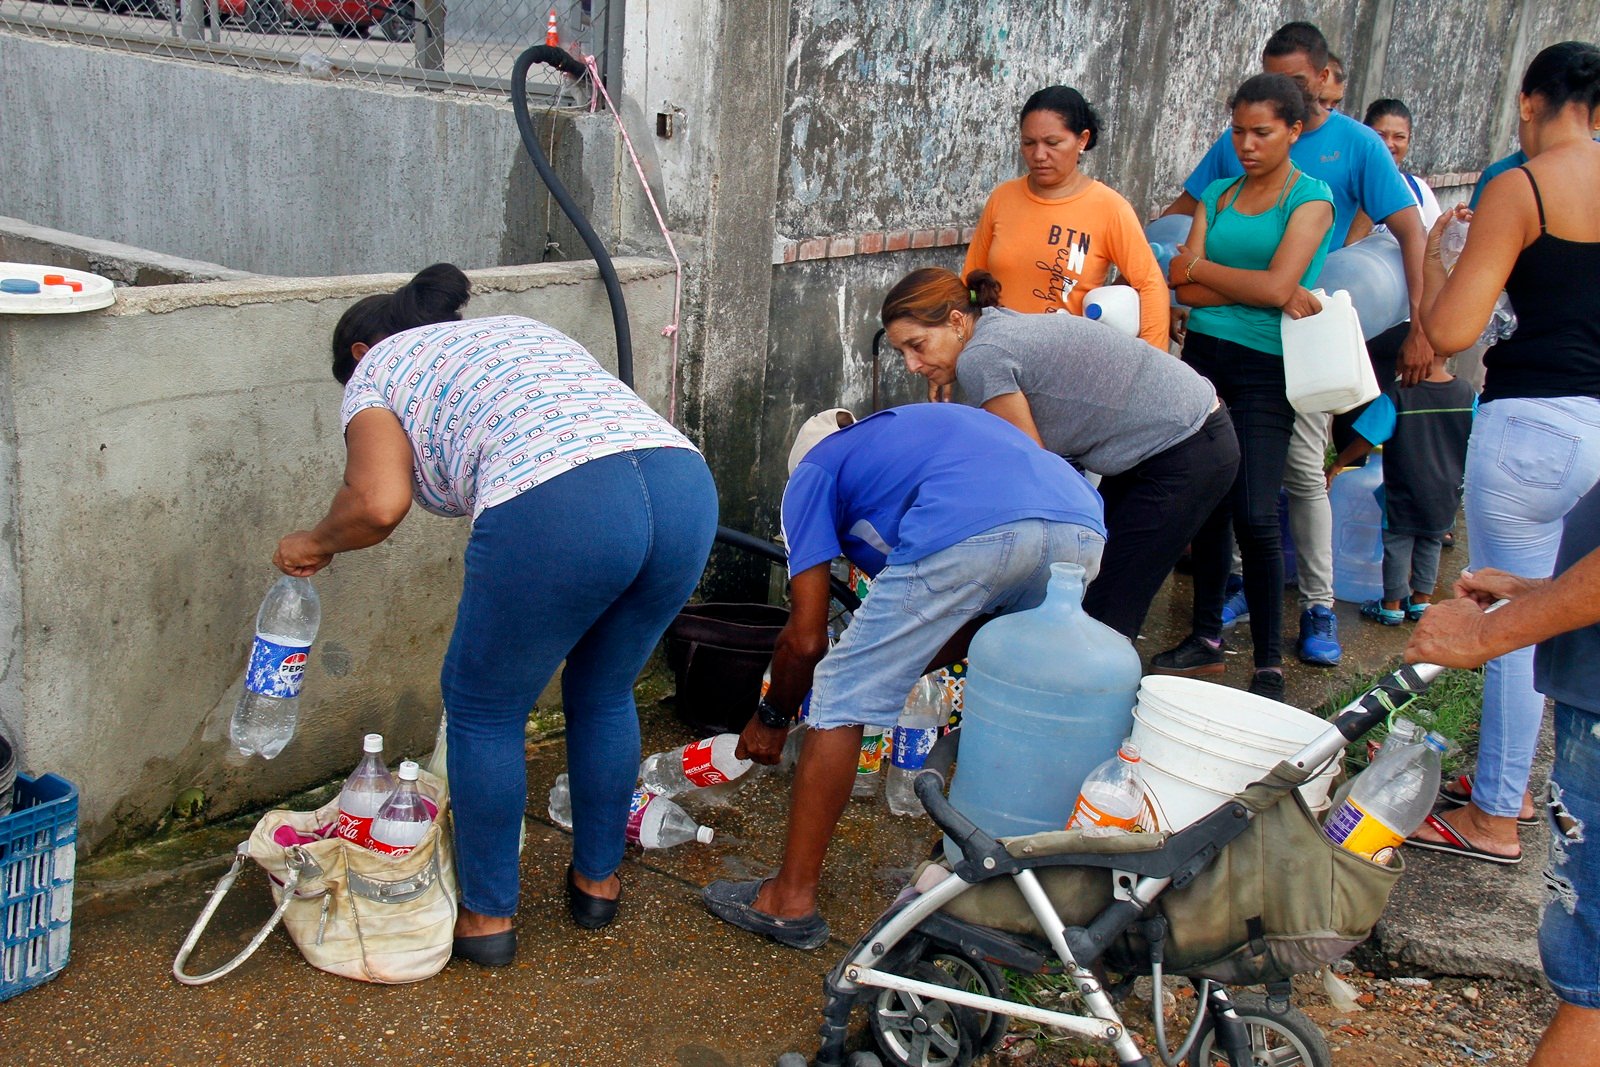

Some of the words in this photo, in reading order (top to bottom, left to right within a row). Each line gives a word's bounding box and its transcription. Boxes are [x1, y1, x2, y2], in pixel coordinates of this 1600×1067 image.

[1048, 224, 1091, 255] BTN
[281, 664, 305, 673] PEPS
[897, 729, 907, 764] PEPSI
